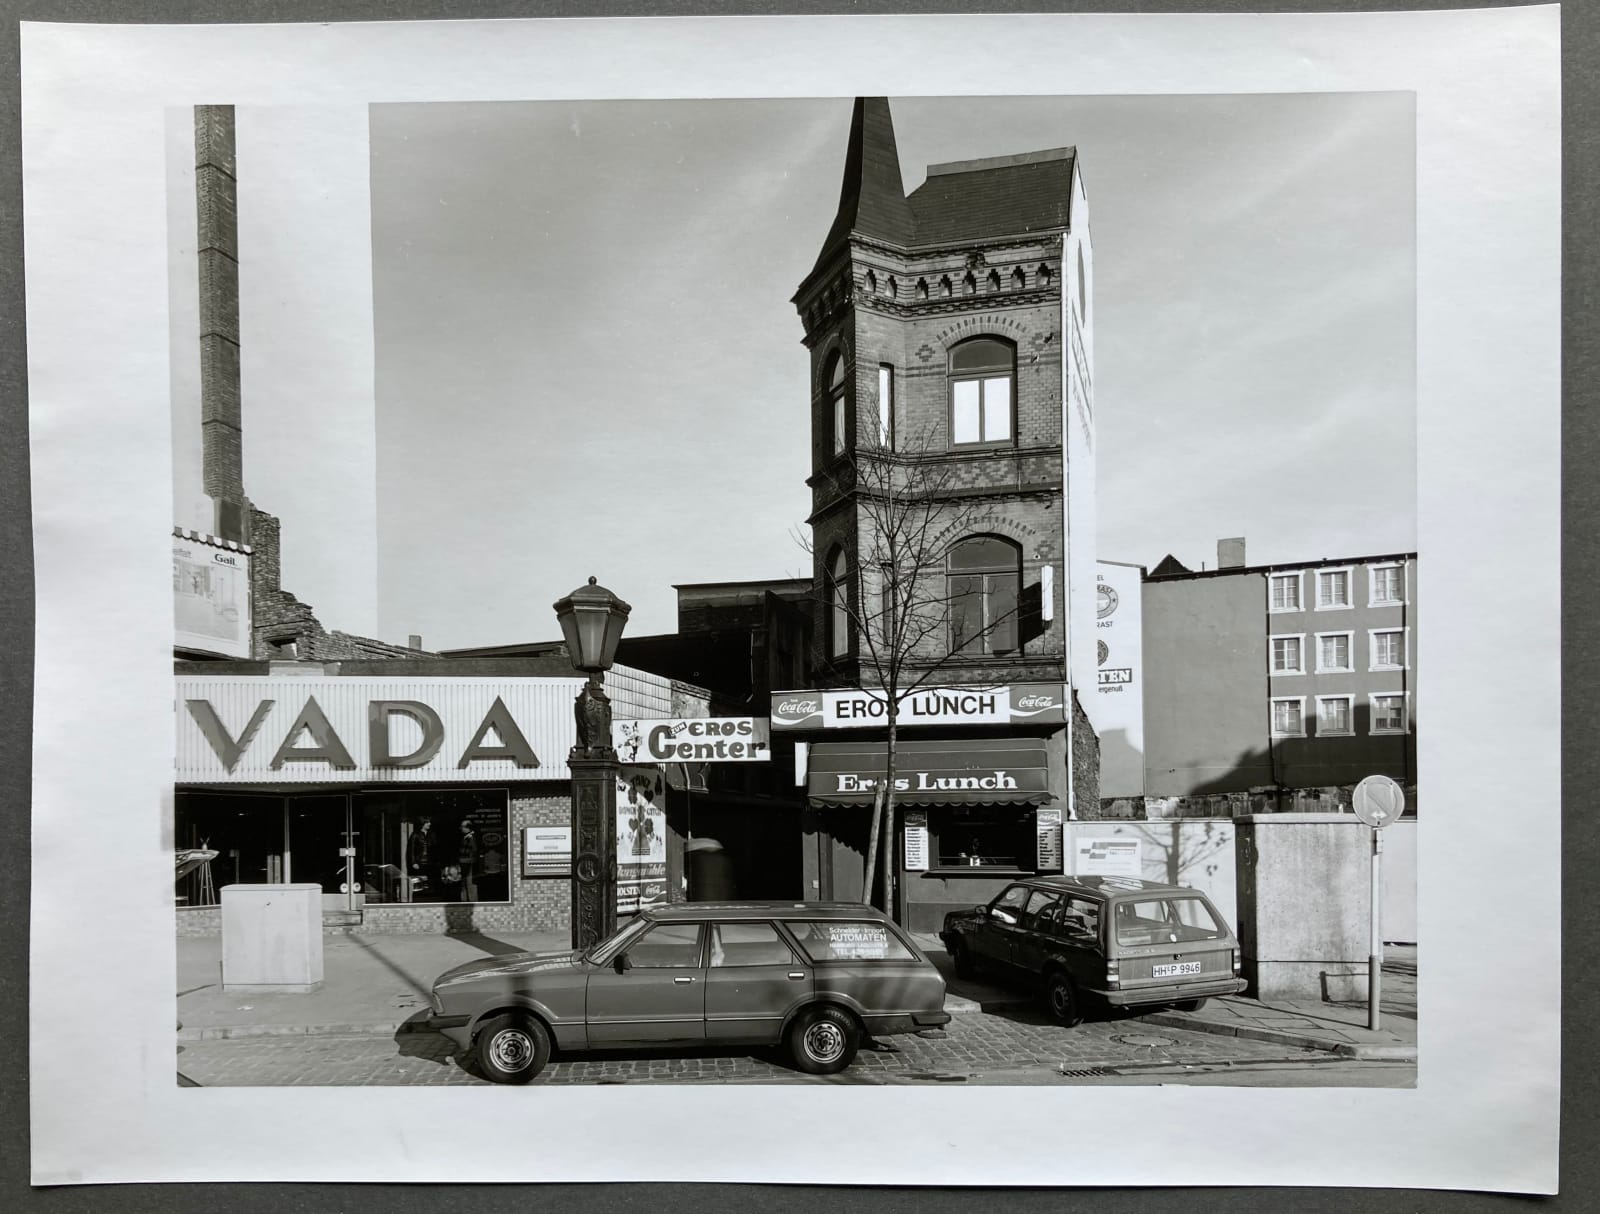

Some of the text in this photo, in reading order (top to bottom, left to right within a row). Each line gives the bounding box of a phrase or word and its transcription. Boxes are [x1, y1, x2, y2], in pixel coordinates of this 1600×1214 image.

[912, 695, 995, 715] LUNCH
[185, 694, 541, 775] VADA
[670, 721, 753, 737] ZUM EROS
[648, 725, 766, 759] Center
[916, 771, 1018, 790] Lunch
[830, 934, 887, 942] AUTOMATEN
